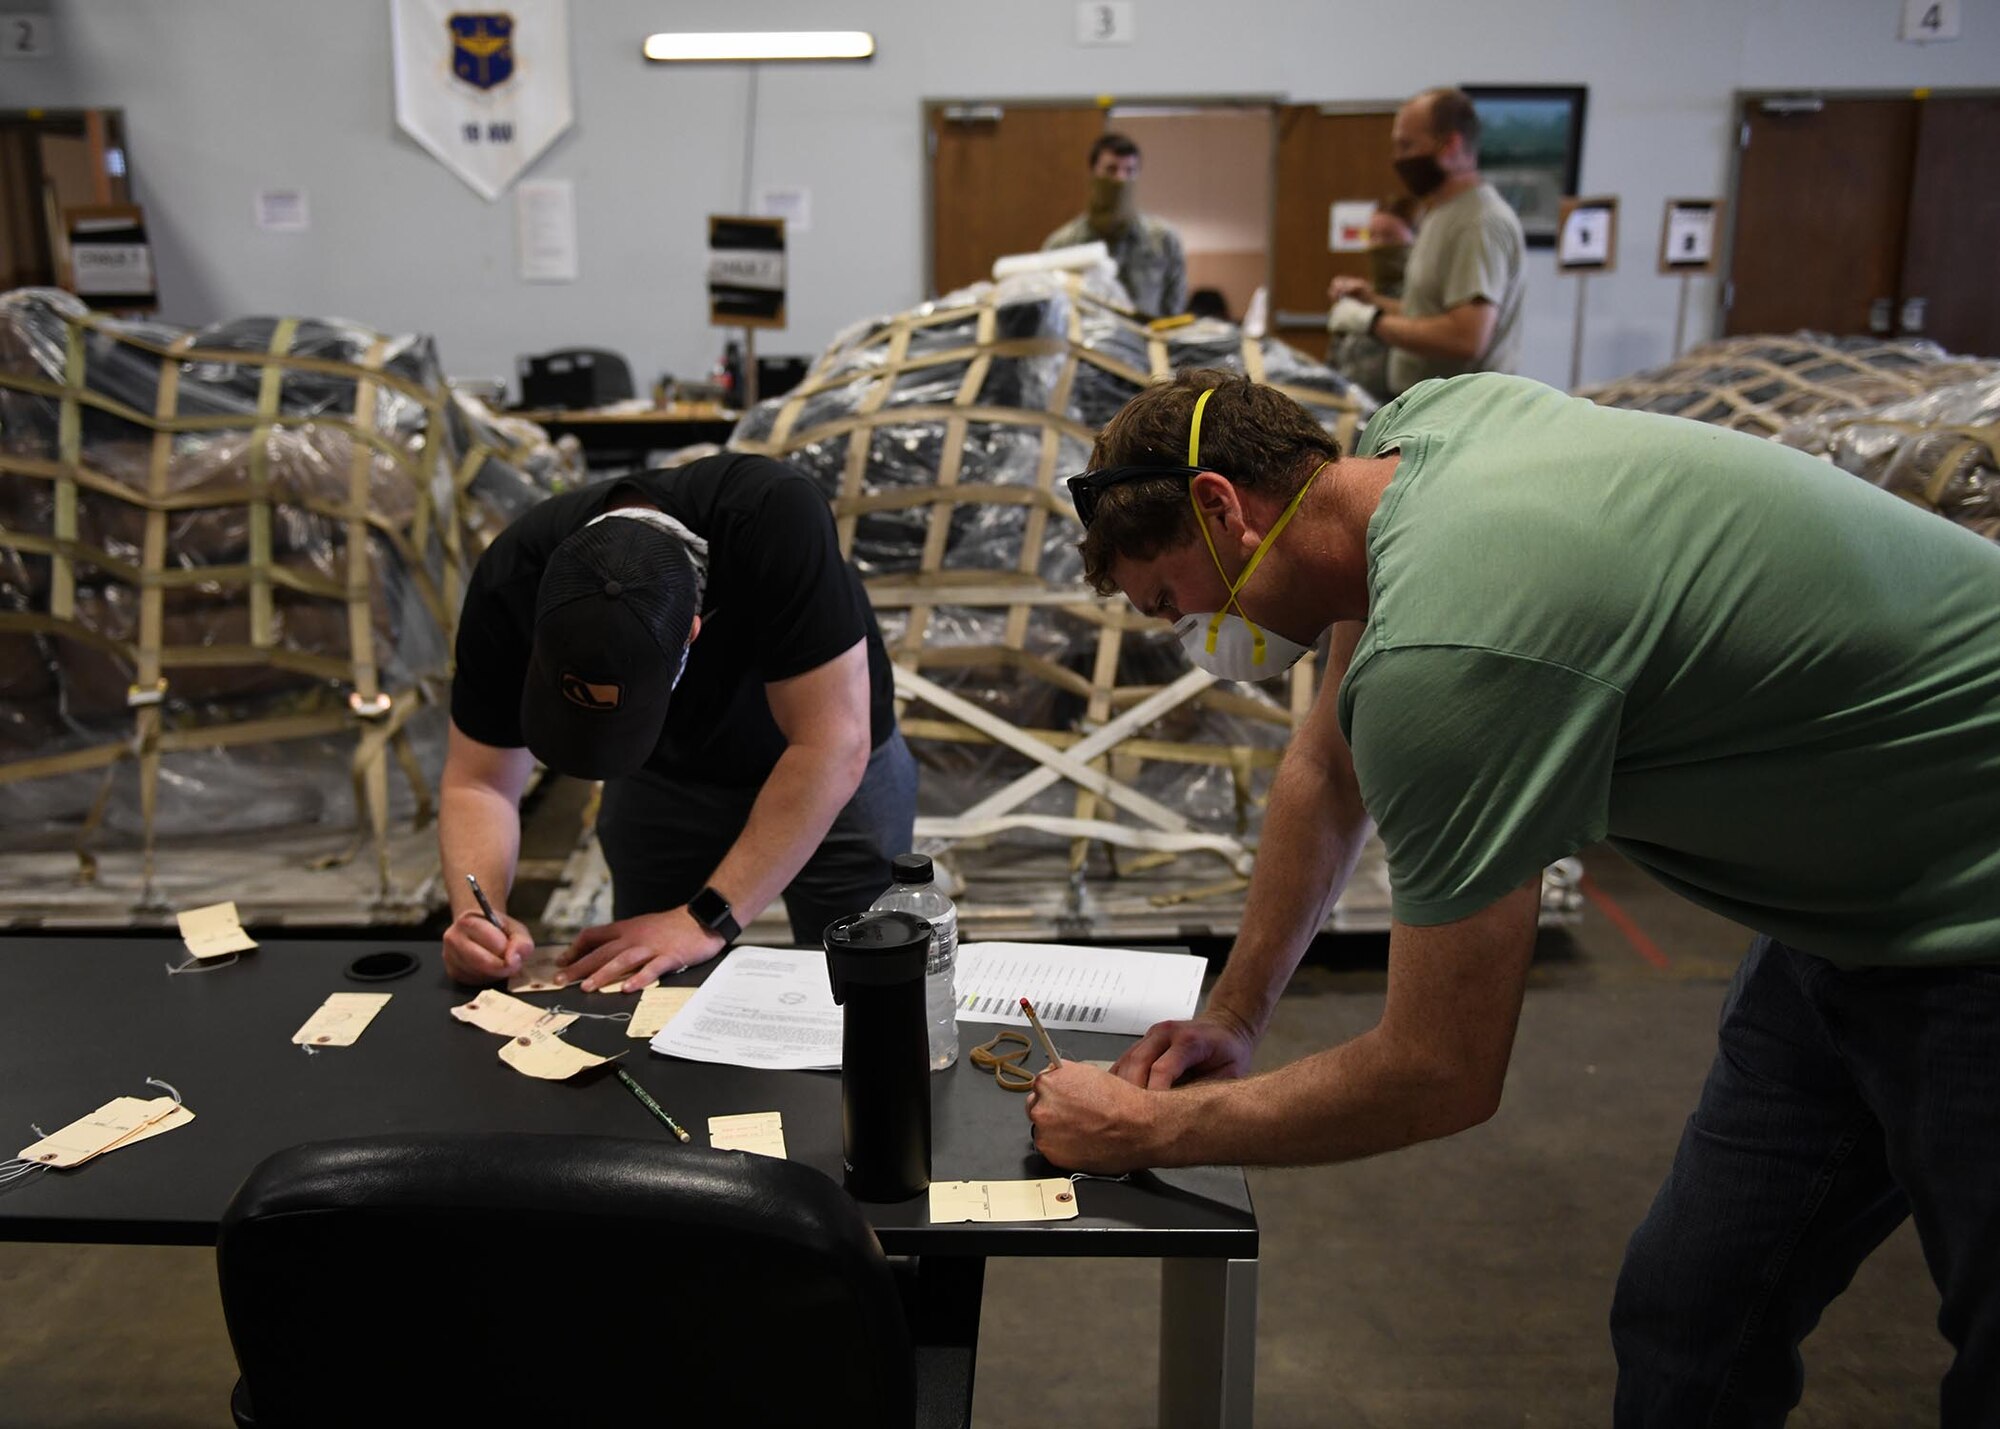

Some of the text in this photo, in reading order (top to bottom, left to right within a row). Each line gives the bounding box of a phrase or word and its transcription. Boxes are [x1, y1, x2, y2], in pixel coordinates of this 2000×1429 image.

[1094, 5, 1116, 39] 3
[1920, 3, 1941, 33] 4
[15, 20, 35, 52] 2
